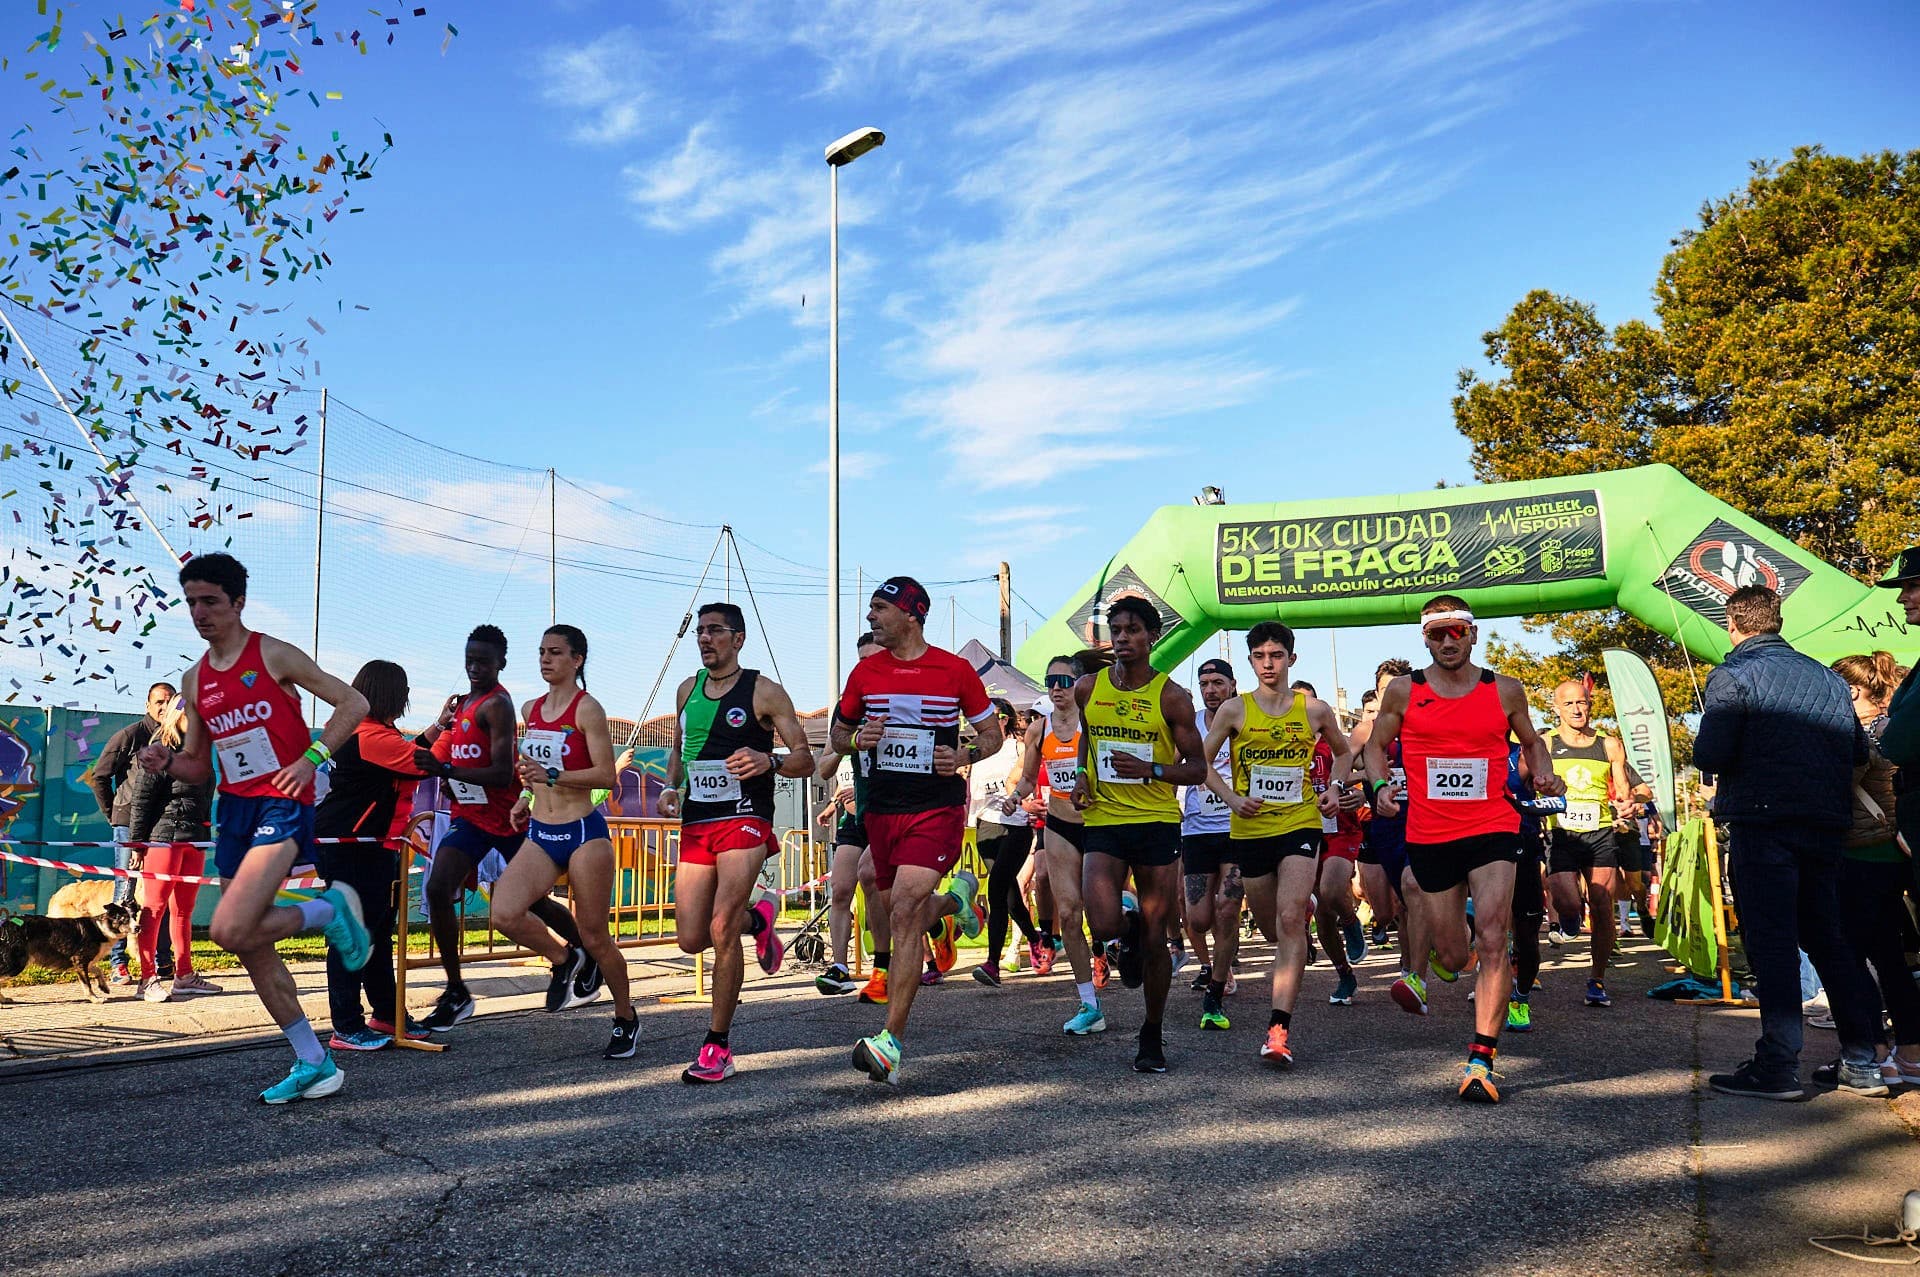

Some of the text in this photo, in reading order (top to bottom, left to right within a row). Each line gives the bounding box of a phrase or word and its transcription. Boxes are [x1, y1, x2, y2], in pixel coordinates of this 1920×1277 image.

[1515, 499, 1582, 517] FARTLECK
[1222, 511, 1452, 553] 5K 10K CIUDAD
[1520, 514, 1584, 534] SPORT
[1221, 540, 1459, 583] DE FRAGA
[1564, 547, 1595, 560] Fraga
[1224, 572, 1461, 598] MEMORIAL JOAQUÍN CALUCHO
[1671, 566, 1731, 606] ATLETIS
[527, 743, 552, 758] 116
[883, 743, 918, 759] 404
[235, 751, 248, 767] 2
[693, 775, 729, 789] 1403
[1053, 770, 1077, 784] 304
[1256, 778, 1294, 792] 1007
[1435, 773, 1474, 788] 202
[458, 782, 468, 793] 3
